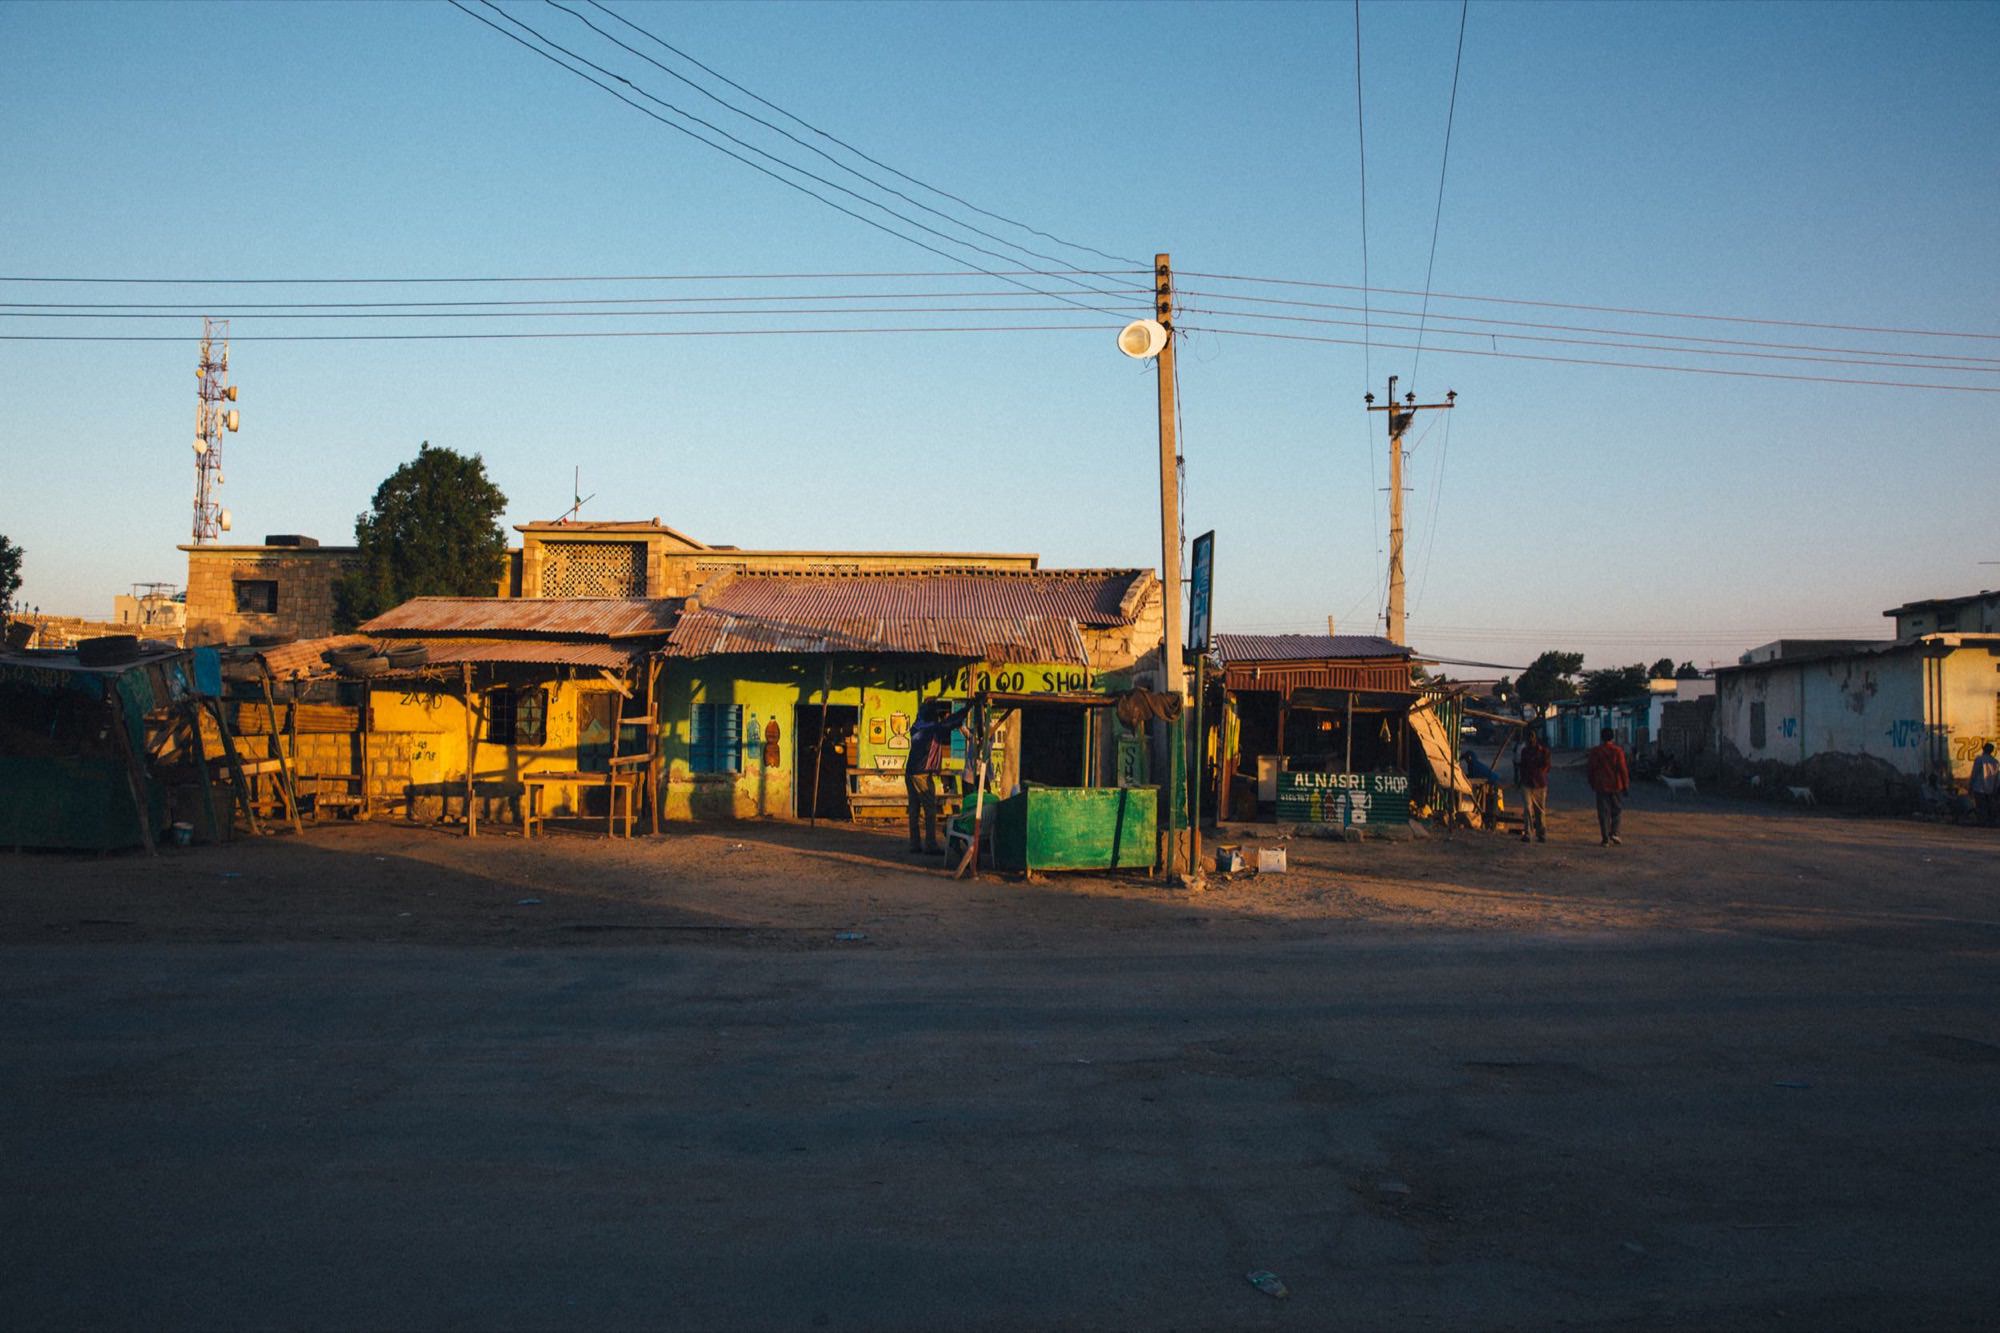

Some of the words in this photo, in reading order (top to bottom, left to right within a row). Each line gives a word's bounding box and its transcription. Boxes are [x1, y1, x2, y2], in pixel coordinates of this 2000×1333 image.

[1042, 672, 1095, 692] SHOP
[1294, 772, 1366, 789] ALNASRI
[1374, 775, 1409, 794] SHOP
